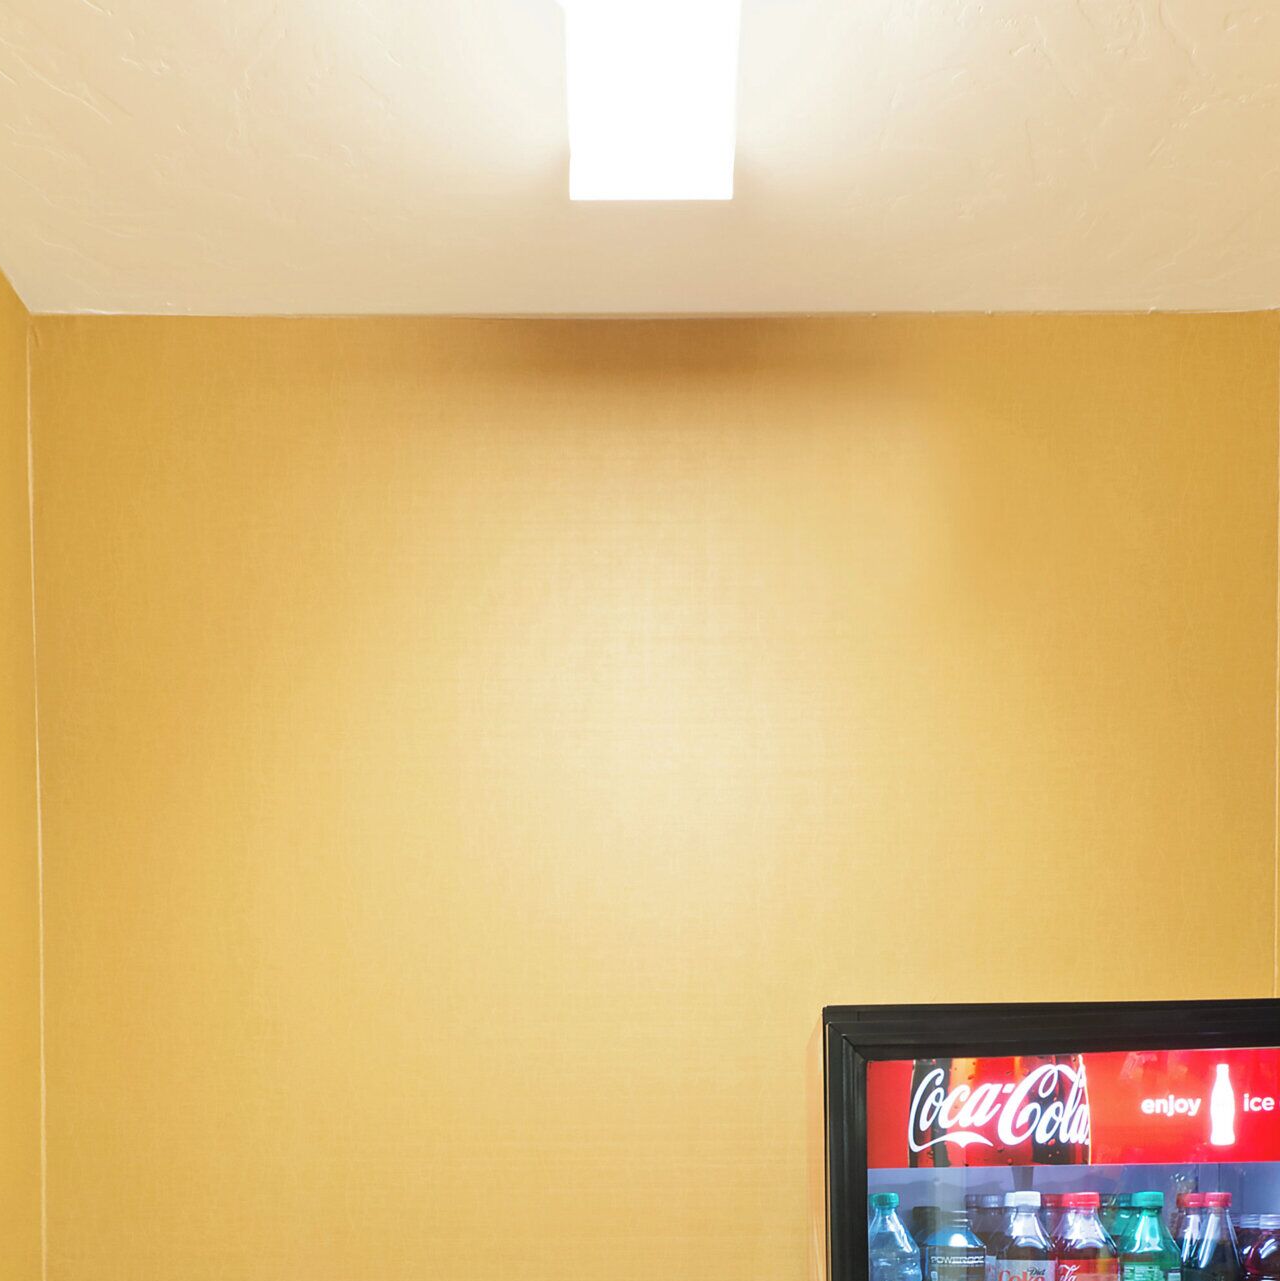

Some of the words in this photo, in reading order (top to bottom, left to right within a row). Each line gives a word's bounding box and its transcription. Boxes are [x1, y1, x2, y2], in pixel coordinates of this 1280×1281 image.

[908, 1063, 1091, 1152] Coca-Cola
[1141, 1094, 1202, 1117] enjoy
[1244, 1094, 1274, 1112] ice
